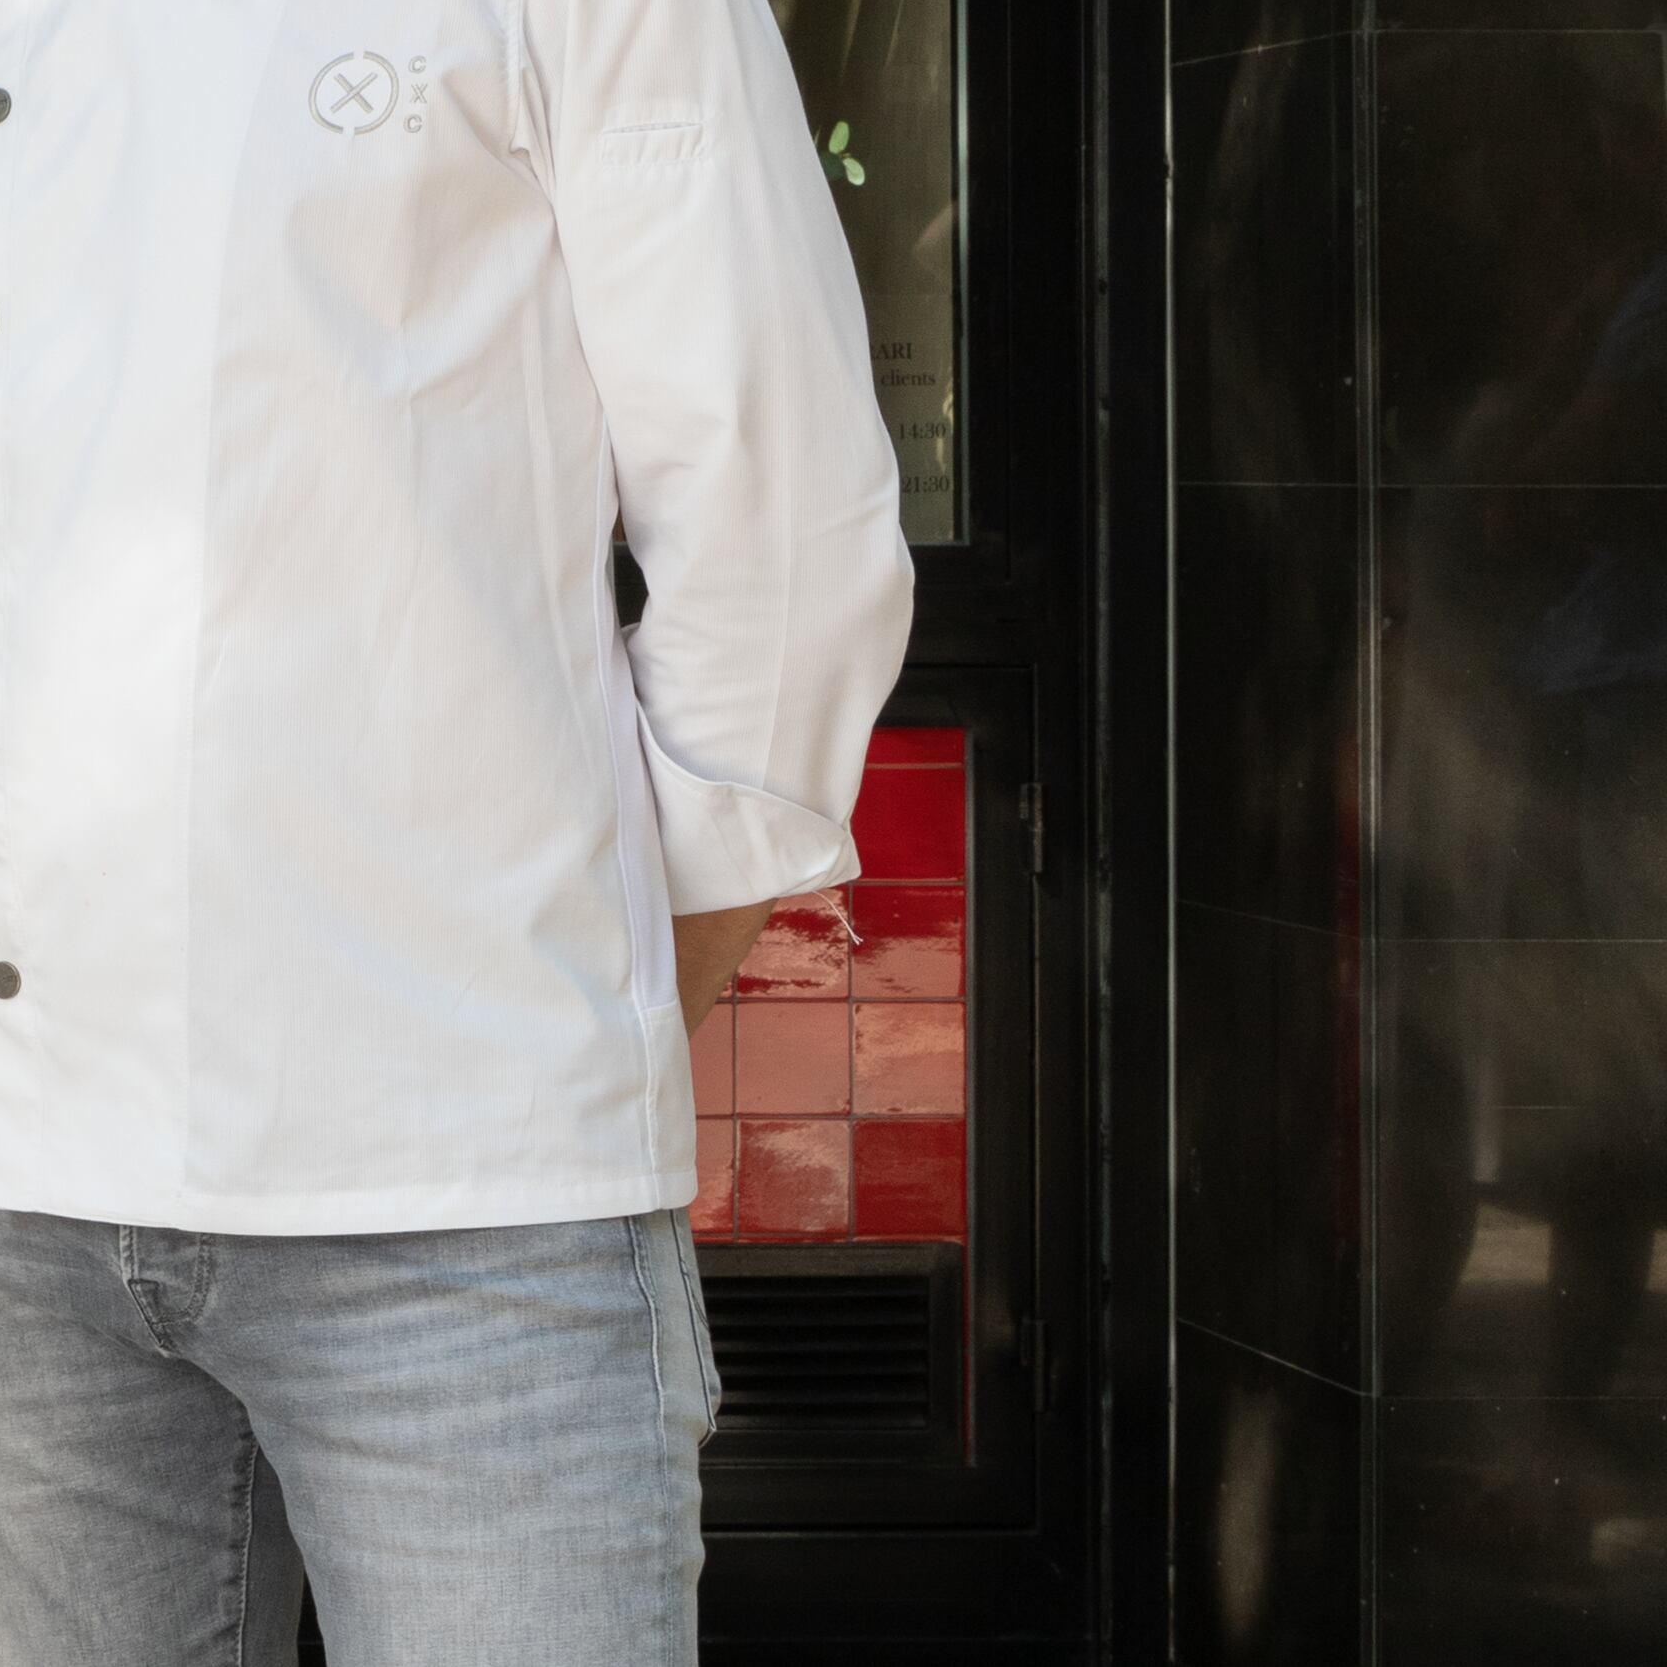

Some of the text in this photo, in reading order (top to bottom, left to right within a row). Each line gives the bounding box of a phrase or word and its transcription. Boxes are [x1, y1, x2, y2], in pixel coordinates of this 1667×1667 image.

[880, 368, 937, 387] clients
[898, 421, 947, 440] 14:30
[901, 474, 951, 494] 21:30
